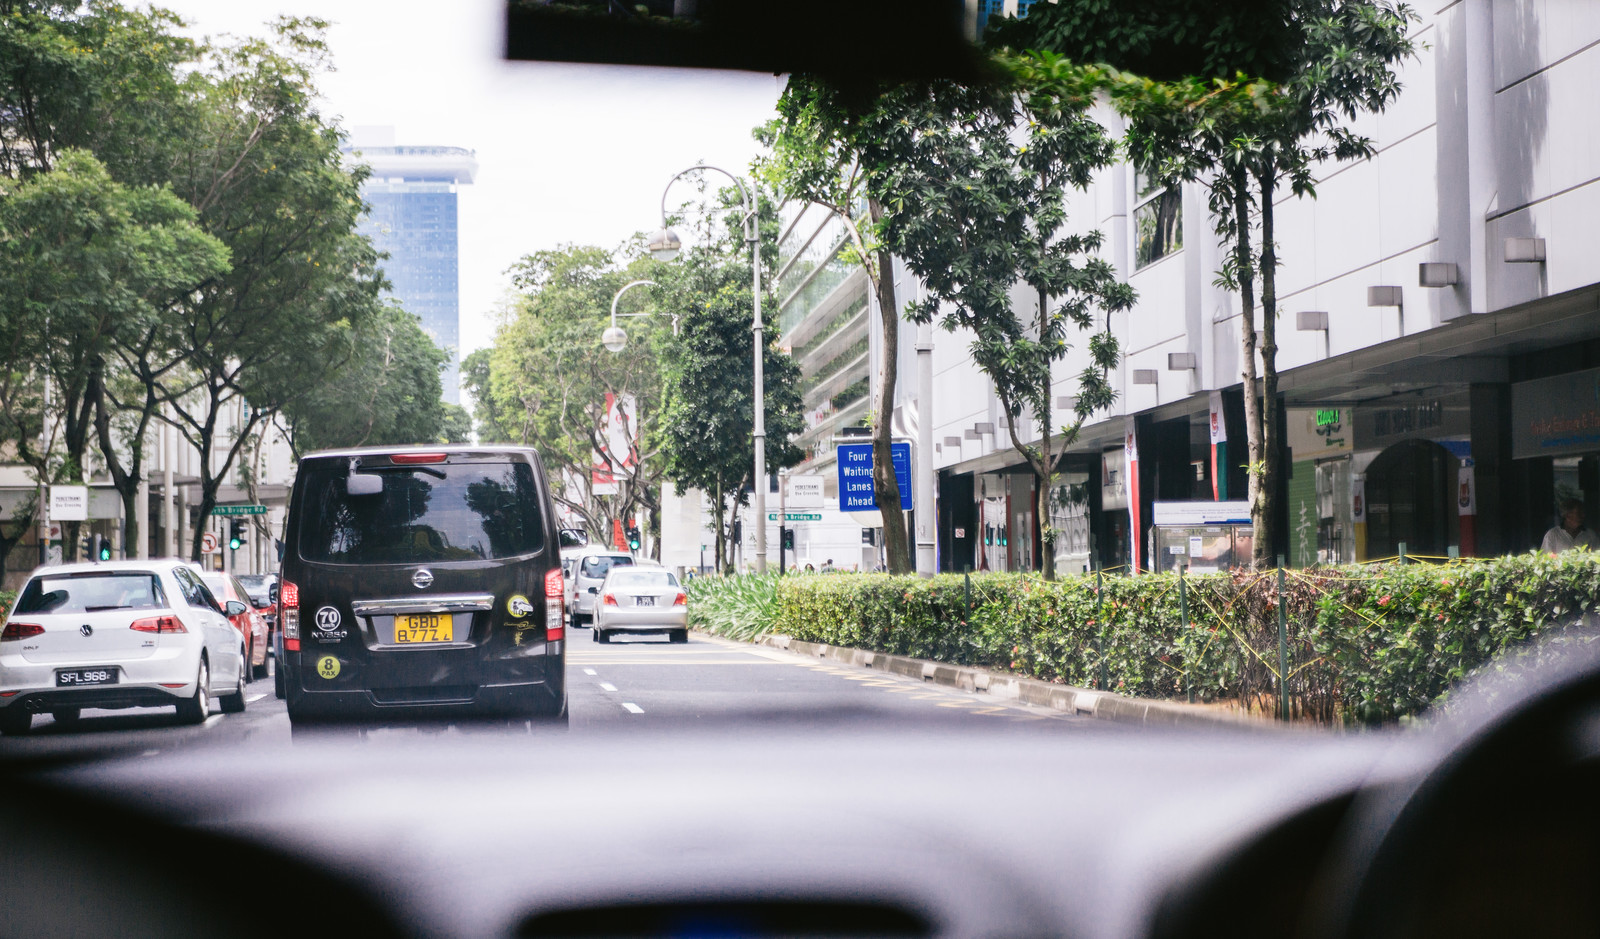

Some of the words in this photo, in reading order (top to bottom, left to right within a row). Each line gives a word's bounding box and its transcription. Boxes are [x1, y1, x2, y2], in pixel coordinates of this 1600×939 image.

[848, 452, 867, 461] Four
[844, 466, 873, 478] Waiting
[847, 482, 872, 492] Lanes
[848, 496, 873, 506] Ahead
[228, 506, 252, 514] Bridge
[320, 611, 338, 624] 70
[408, 616, 438, 628] GBD
[324, 658, 333, 670] 8
